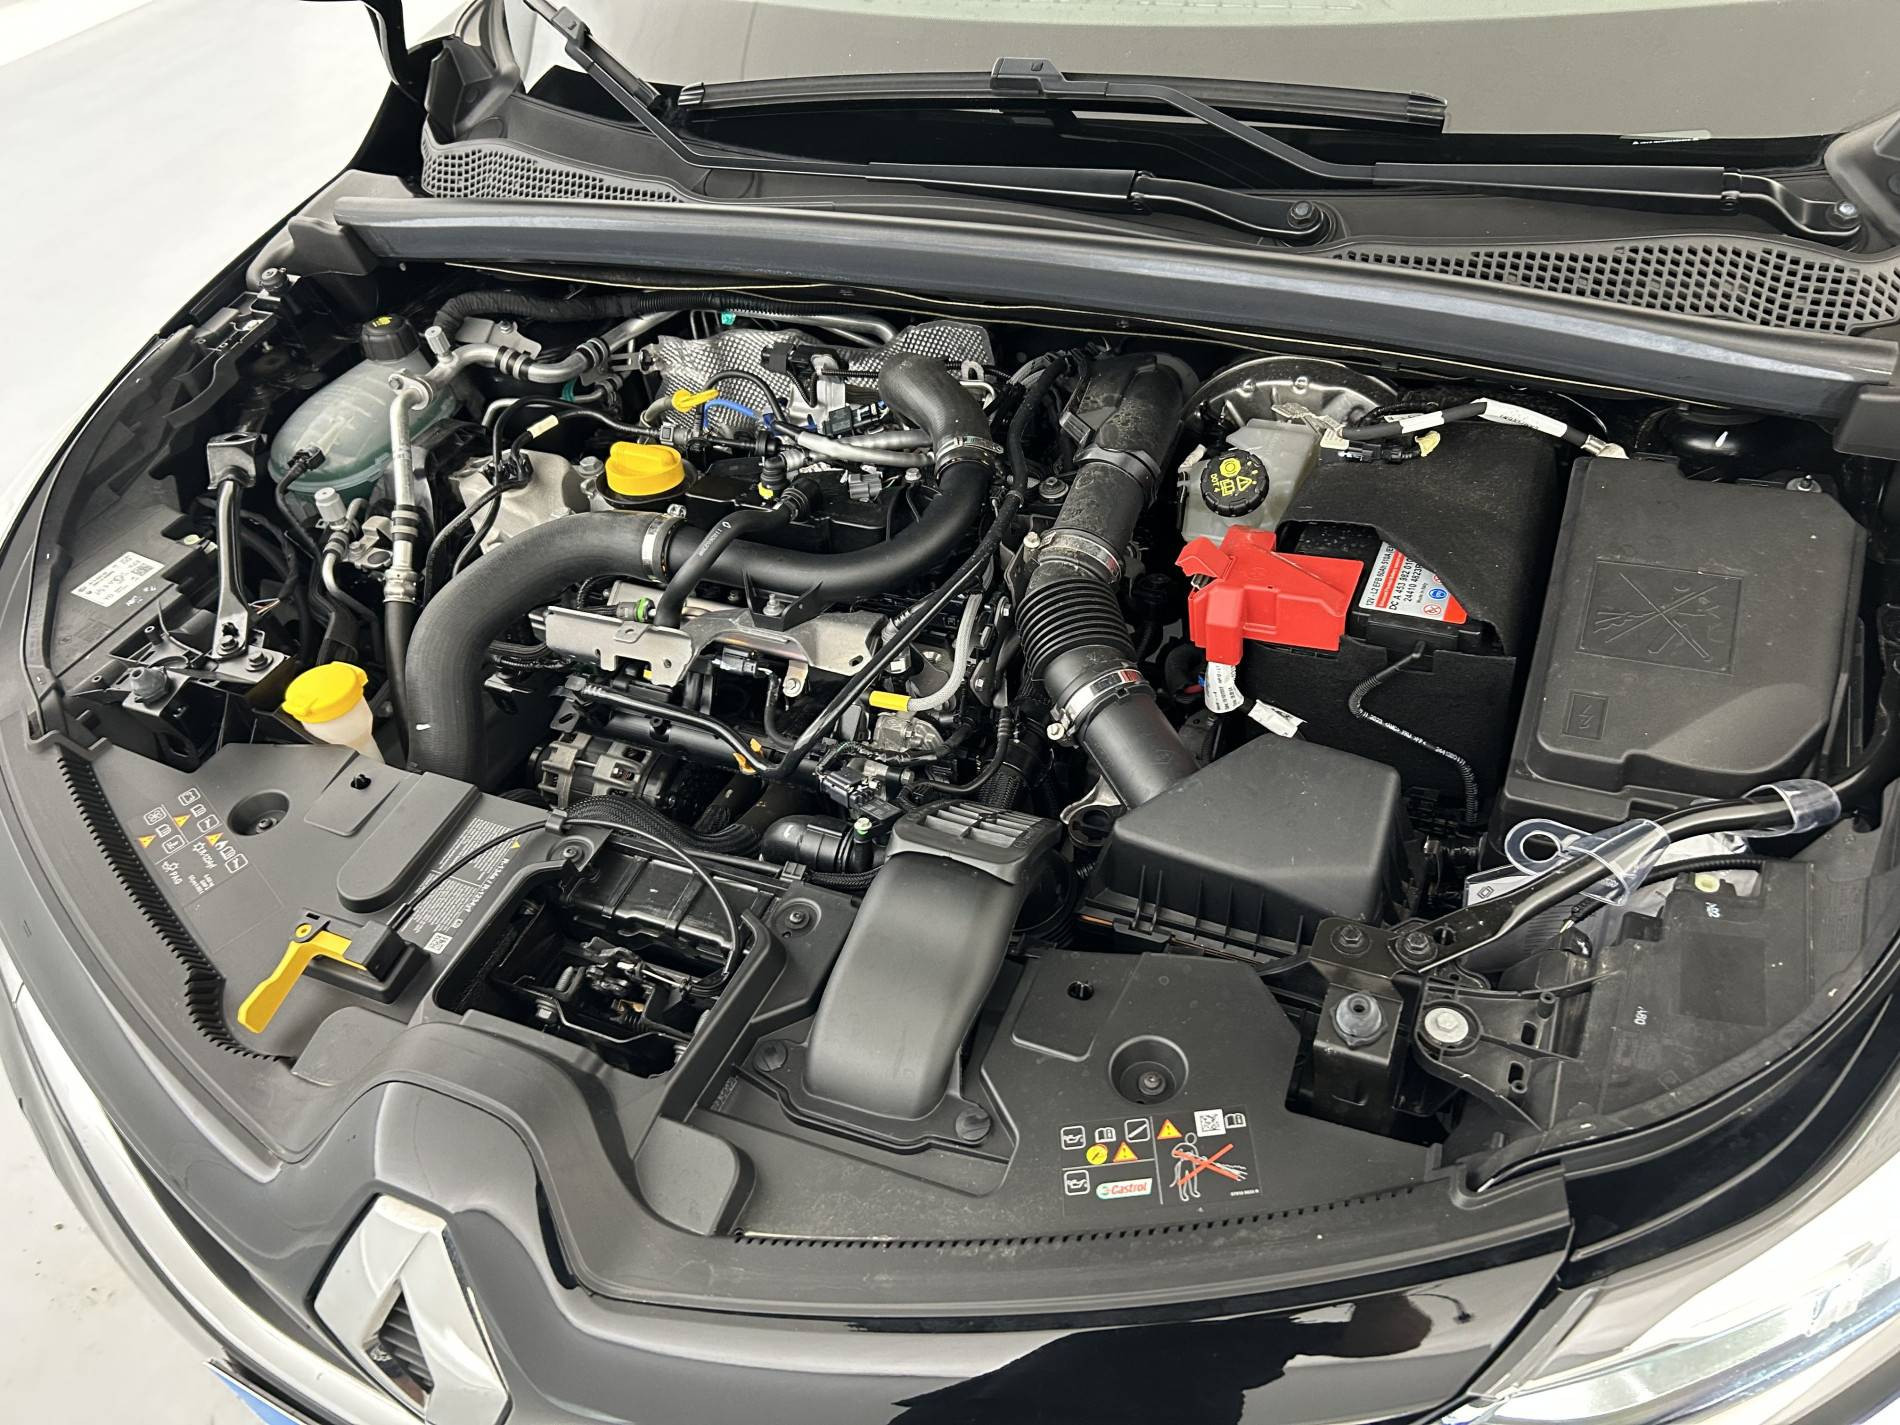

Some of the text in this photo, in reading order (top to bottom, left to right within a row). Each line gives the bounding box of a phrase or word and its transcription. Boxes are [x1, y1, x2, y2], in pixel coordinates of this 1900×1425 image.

[1211, 473, 1219, 487] DOT
[1366, 597, 1375, 605] 12V
[1373, 577, 1382, 587] EFB
[1389, 600, 1399, 610] DC
[1396, 582, 1406, 593] 453
[1403, 583, 1417, 601] 24410
[169, 871, 183, 885] PAG
[1112, 1182, 1148, 1196] Castrol
